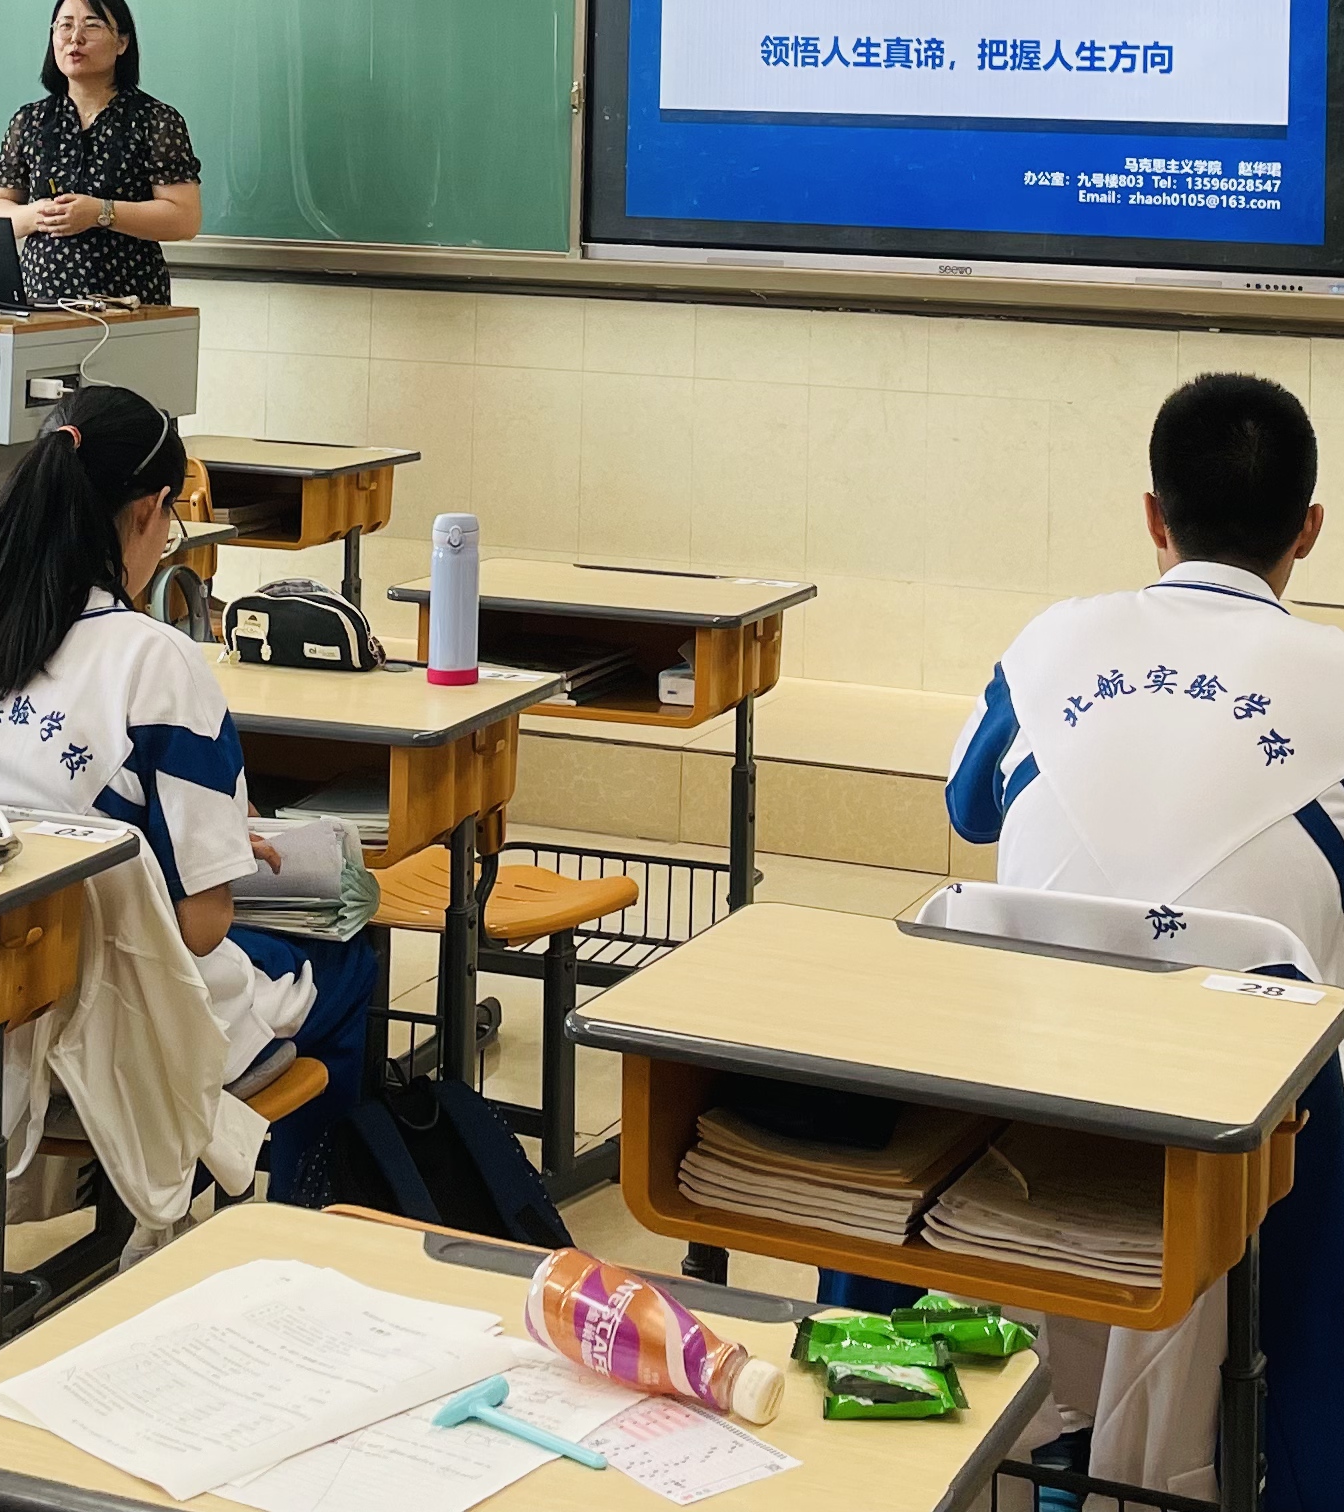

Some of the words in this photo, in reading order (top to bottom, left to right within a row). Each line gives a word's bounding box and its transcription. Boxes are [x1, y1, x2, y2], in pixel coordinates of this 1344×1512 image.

[760, 34, 1174, 74] 领悟人生真谛，把握人生方向
[1124, 157, 1222, 176] 马克思主义学院
[938, 264, 973, 275] seewo
[1063, 665, 1295, 767] 北航实验学校
[1237, 982, 1286, 997] 28
